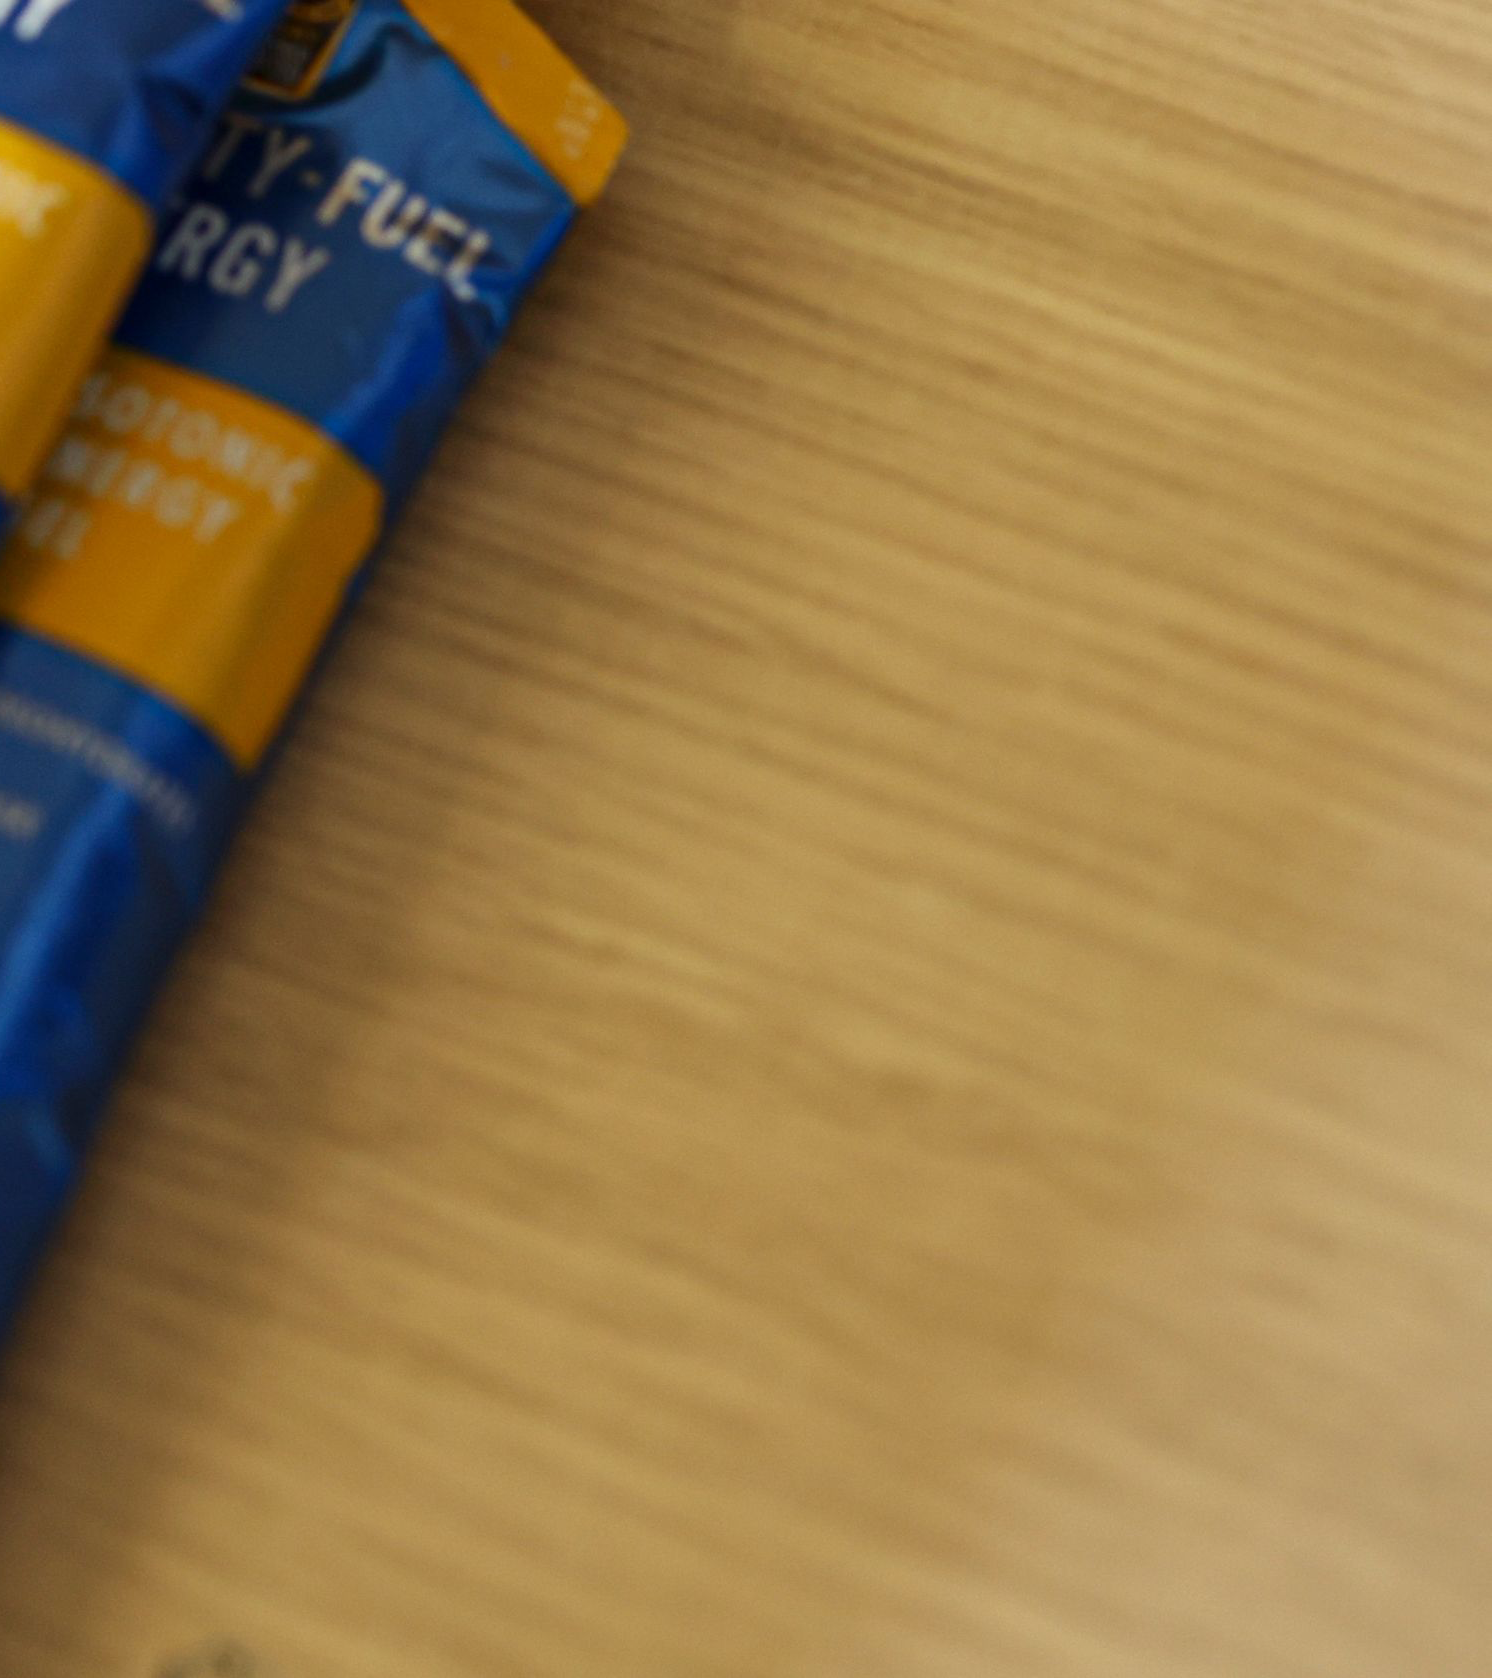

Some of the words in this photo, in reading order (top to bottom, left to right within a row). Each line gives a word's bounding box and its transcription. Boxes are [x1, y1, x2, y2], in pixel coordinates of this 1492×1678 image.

[156, 200, 331, 316] RGY
[208, 119, 496, 304] TY-FUEL
[52, 436, 253, 550] NERGY
[76, 372, 320, 518] SOTONIC
